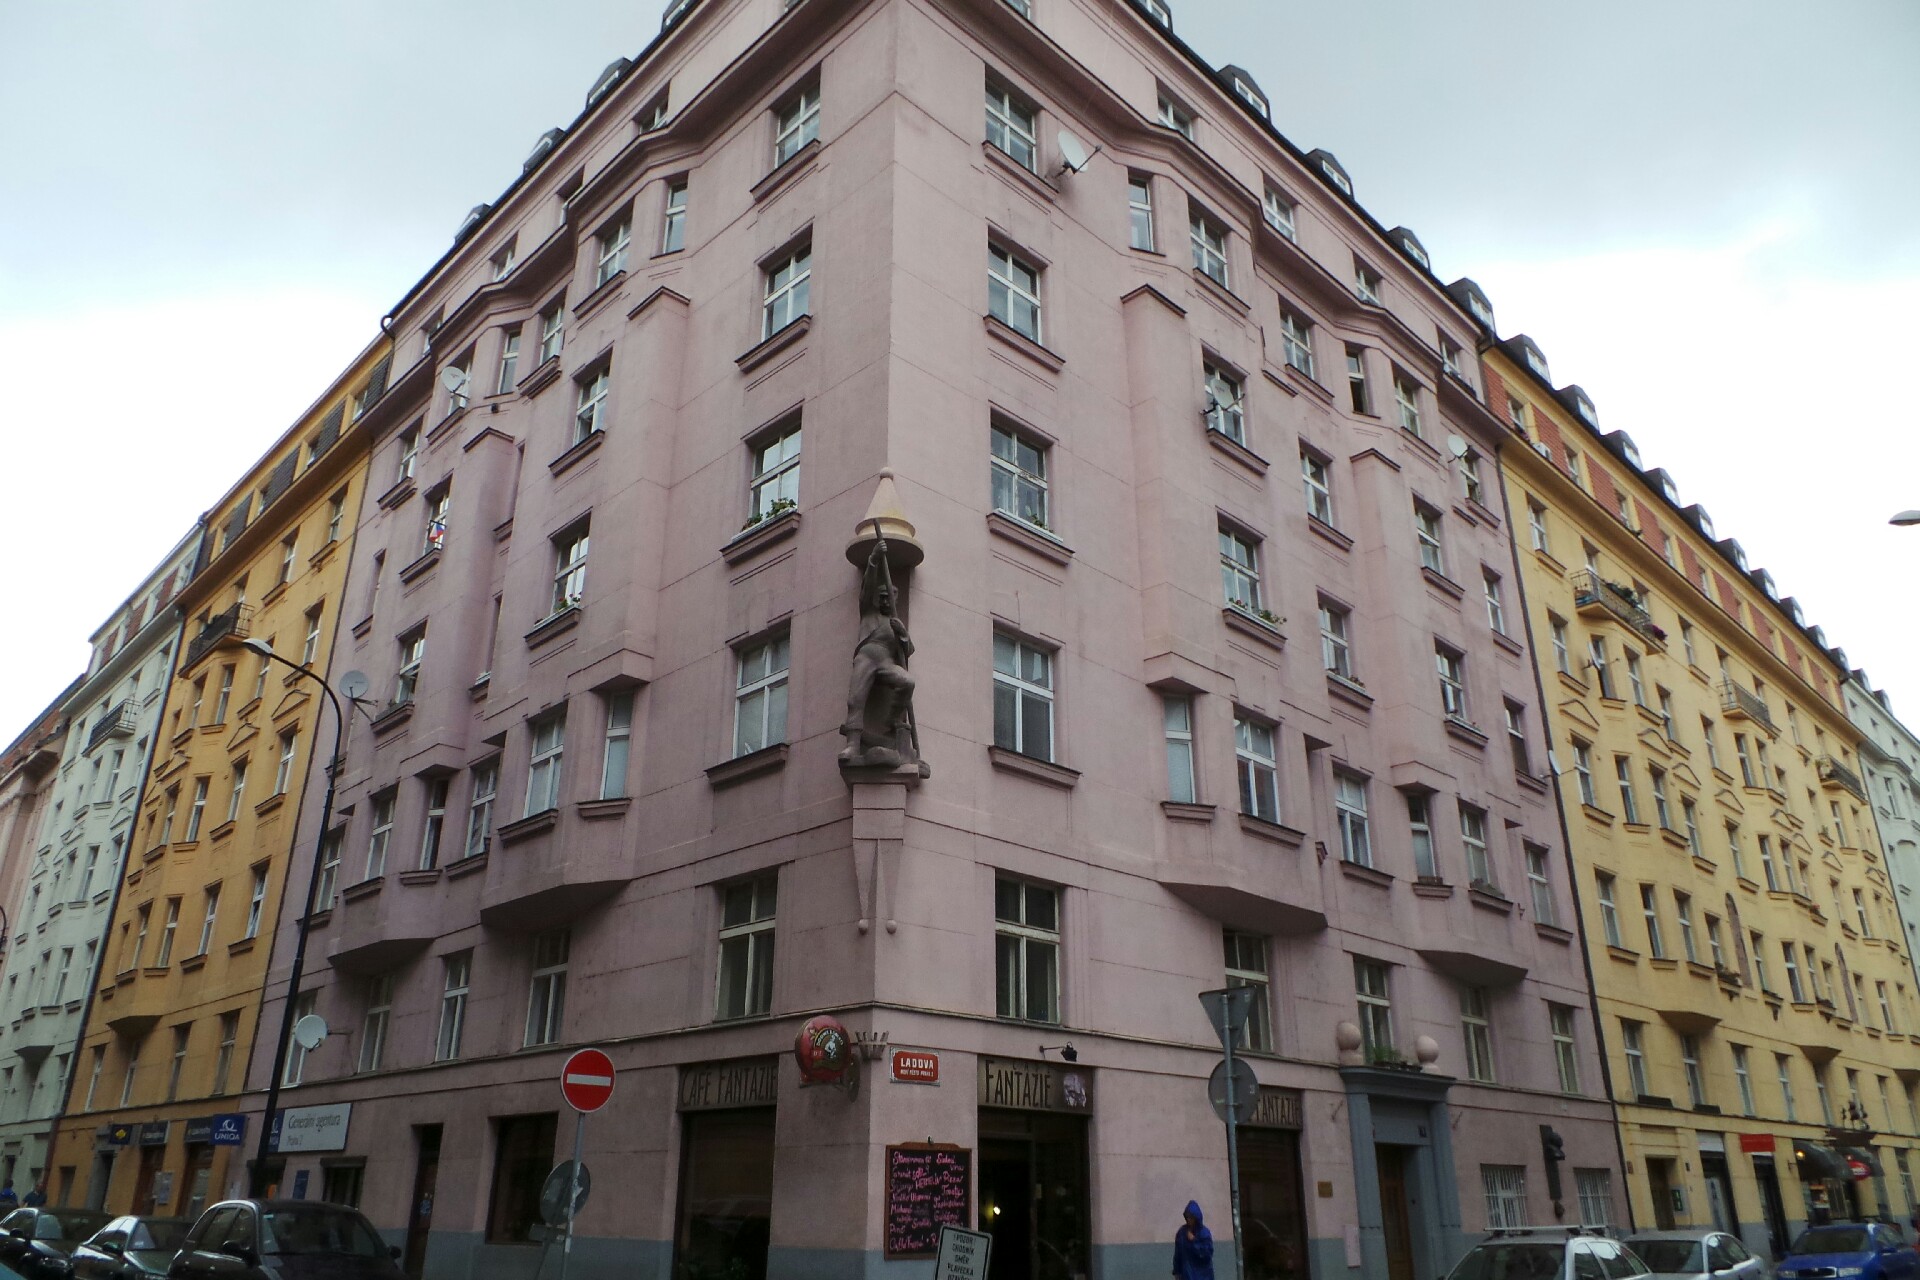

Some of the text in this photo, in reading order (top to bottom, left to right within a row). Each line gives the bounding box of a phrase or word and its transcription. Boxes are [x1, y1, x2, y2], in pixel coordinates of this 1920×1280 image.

[900, 1057, 935, 1069] LADOVA
[681, 1064, 778, 1106] CAFÉ FANTAZIE
[985, 1060, 1051, 1109] FANTAZIE
[214, 1132, 240, 1140] UNIQA
